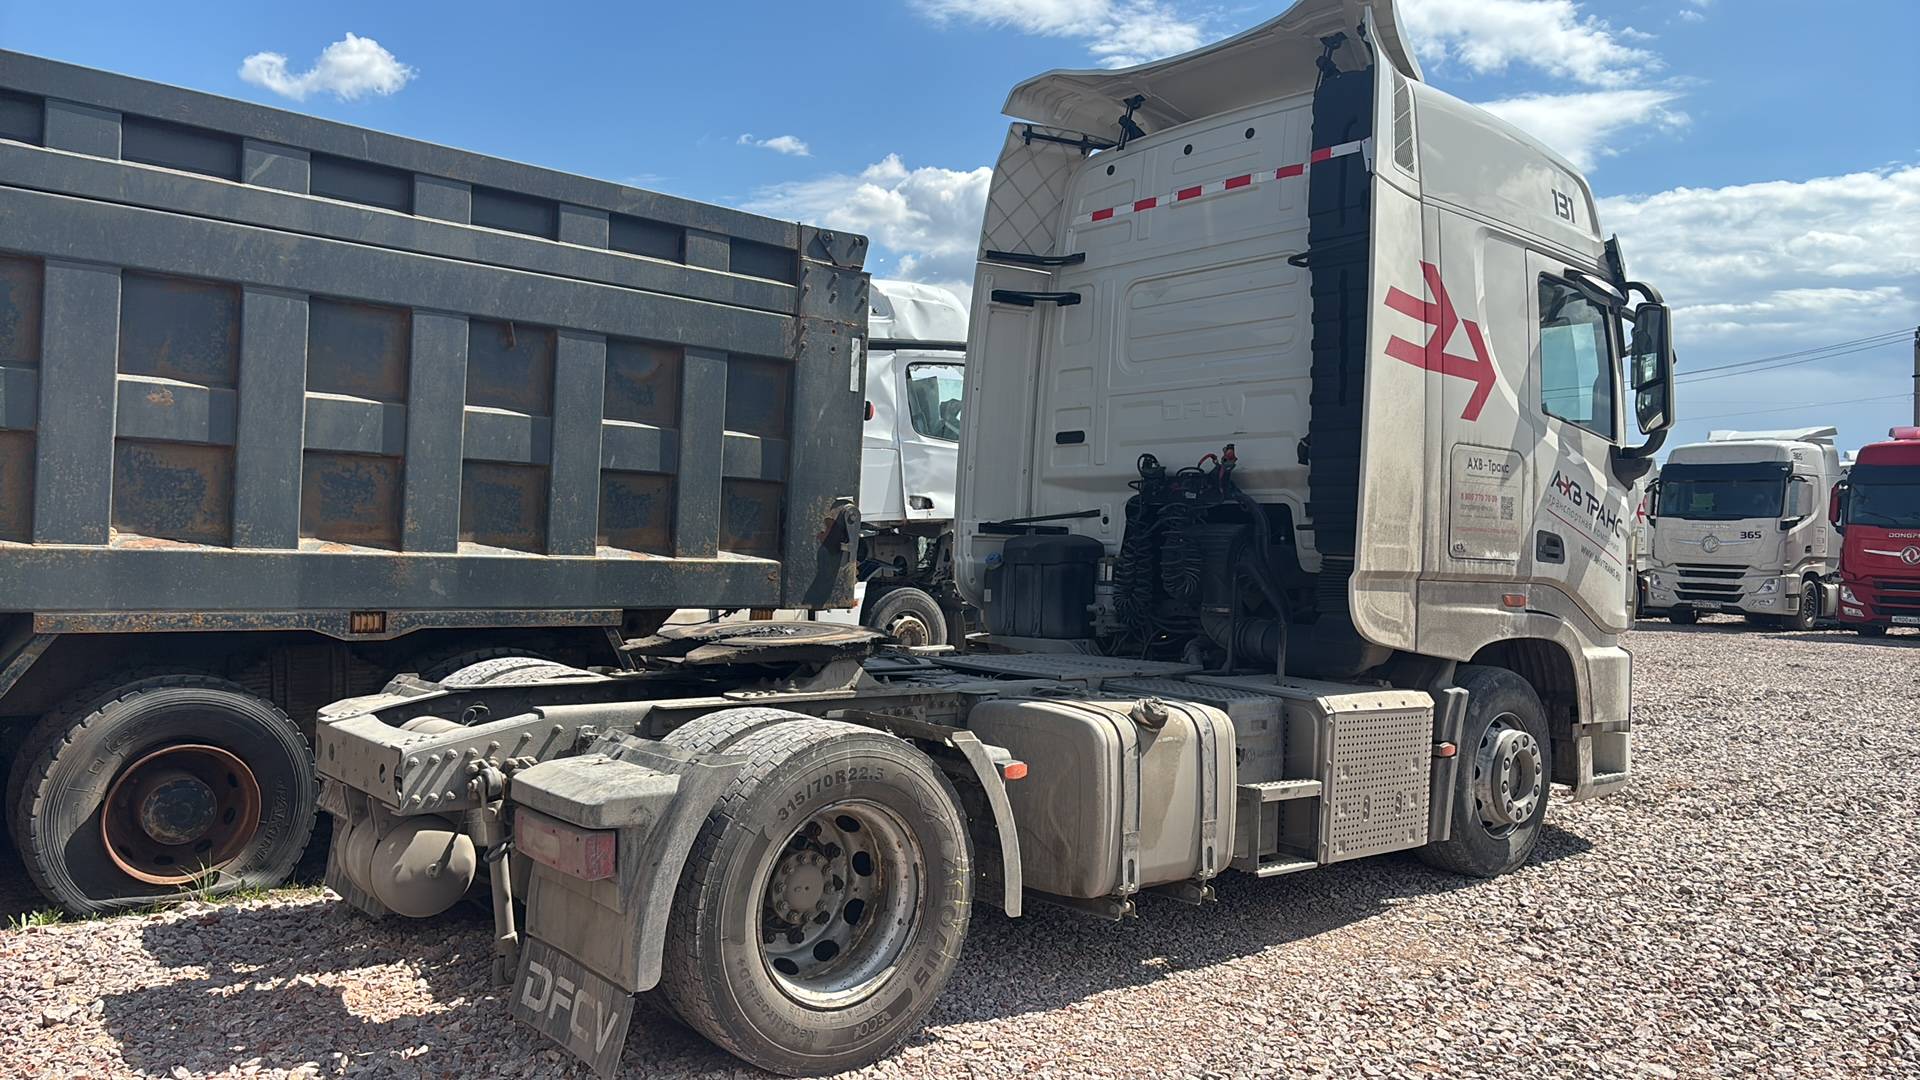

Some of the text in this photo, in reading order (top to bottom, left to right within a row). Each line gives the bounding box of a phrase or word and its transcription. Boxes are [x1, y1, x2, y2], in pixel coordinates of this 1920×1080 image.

[1551, 188, 1575, 224] 131
[1550, 470, 1622, 539] АХВ ТРАНС
[1739, 530, 1762, 540] 365
[777, 767, 885, 821] 315/70R22.5
[520, 960, 619, 1054] DFCV
